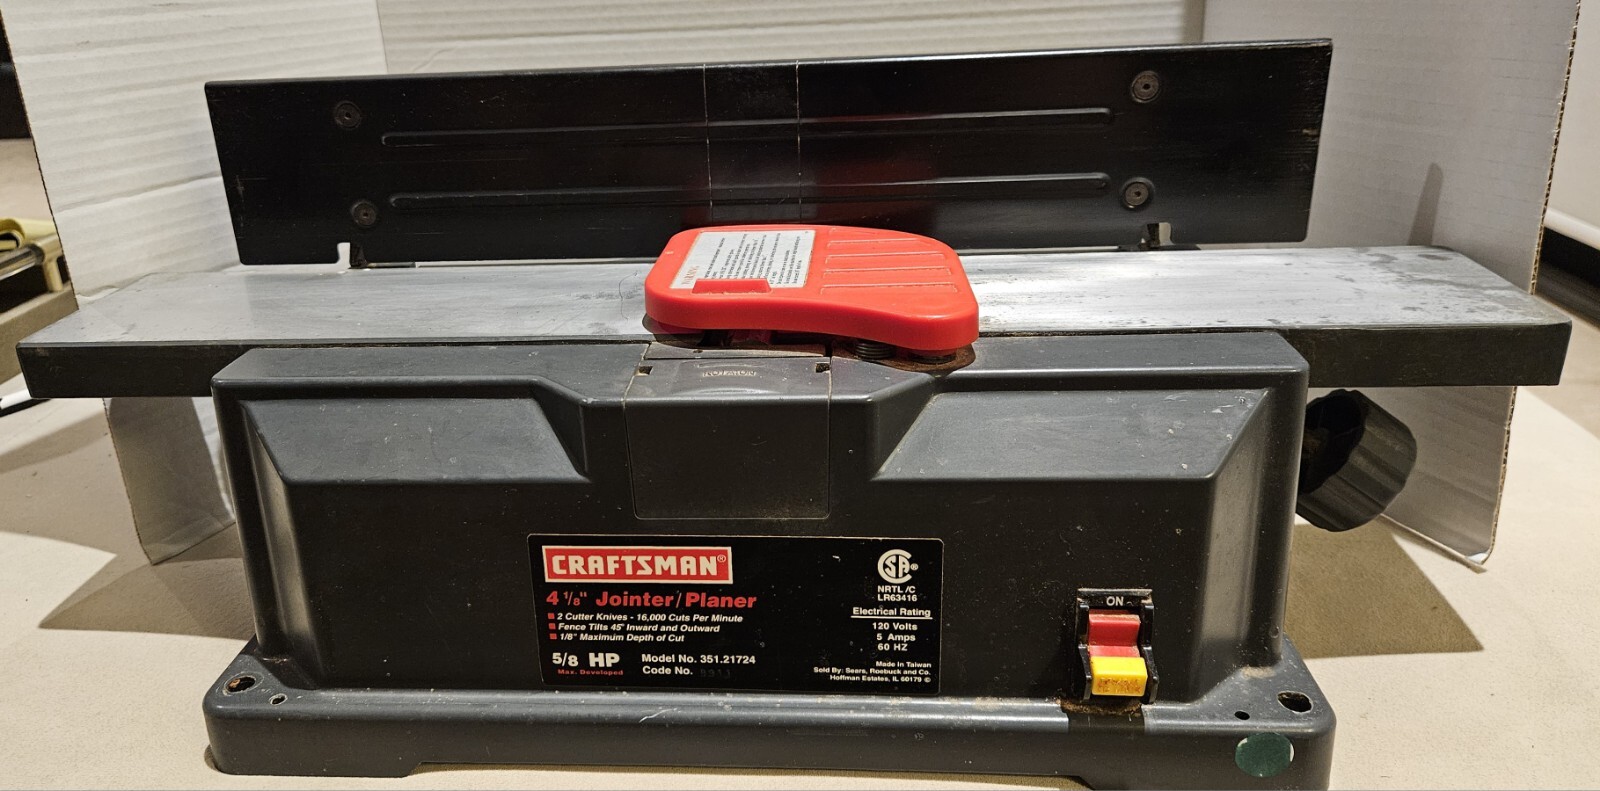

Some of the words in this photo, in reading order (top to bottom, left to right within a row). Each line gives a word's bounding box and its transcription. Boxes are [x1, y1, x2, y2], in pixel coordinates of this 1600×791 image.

[546, 591, 559, 606] 4
[877, 594, 918, 602] LR63416
[1106, 596, 1124, 606] ON
[557, 613, 563, 621] 2
[565, 612, 594, 621] Cutter
[596, 613, 628, 621] Knives
[636, 613, 667, 623] 16,000
[668, 613, 691, 622] Cuts
[694, 614, 709, 622] Per
[711, 614, 744, 623] Minute
[852, 607, 897, 616] Electrical
[899, 607, 931, 618] Rating
[558, 623, 587, 631] Fence
[589, 623, 609, 631] Tilts
[626, 623, 659, 632] Inward
[660, 624, 679, 632] and
[680, 624, 721, 633] Outward
[872, 622, 890, 630] 120
[892, 622, 918, 631] Volts
[580, 633, 625, 641] Maximum
[627, 633, 654, 643] Depth
[656, 633, 667, 642] of
[668, 634, 685, 642] Cut
[876, 633, 883, 641] 5
[887, 633, 916, 642] Amps
[877, 643, 890, 651] 60
[893, 643, 908, 651] HZ
[552, 652, 579, 667] 5/8
[588, 652, 620, 667] HP
[641, 654, 676, 663] Model
[678, 654, 697, 664] No.
[700, 655, 756, 664] 351.21724
[642, 665, 672, 675] Code
[674, 666, 694, 675] No.
[845, 667, 868, 675] Sears,
[861, 675, 891, 683] Estates,
